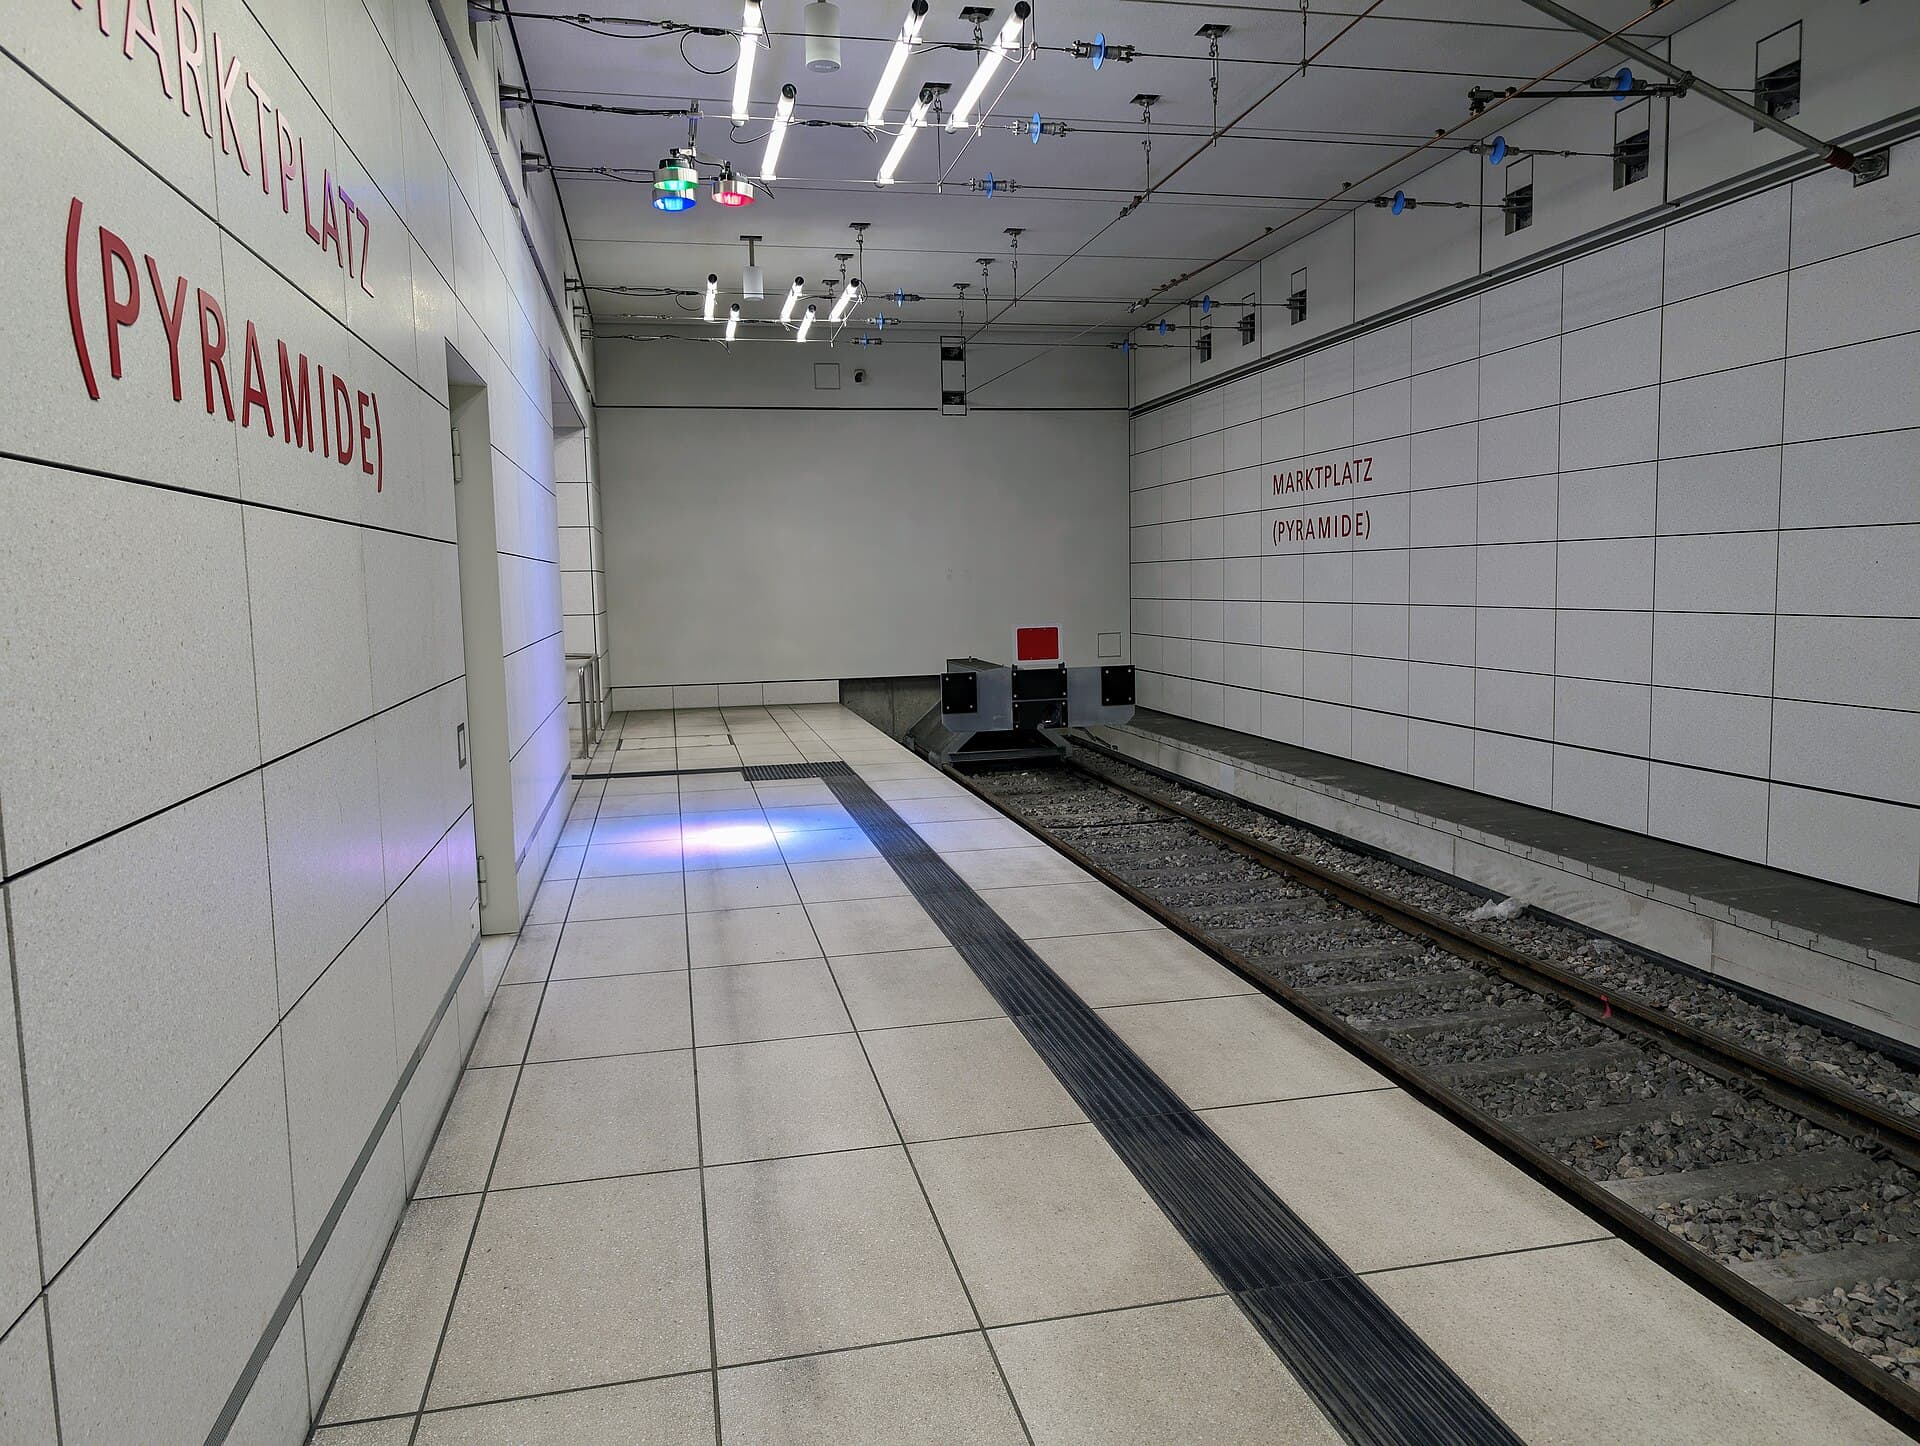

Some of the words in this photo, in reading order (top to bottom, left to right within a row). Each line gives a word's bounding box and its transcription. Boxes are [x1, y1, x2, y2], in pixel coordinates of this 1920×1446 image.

[72, 0, 375, 298] ARKTPLATZ
[65, 196, 384, 493] (PYRAMIDE)
[1272, 457, 1373, 496] MARKTPLATZ
[1272, 510, 1371, 547] (PYRAMIDE)
